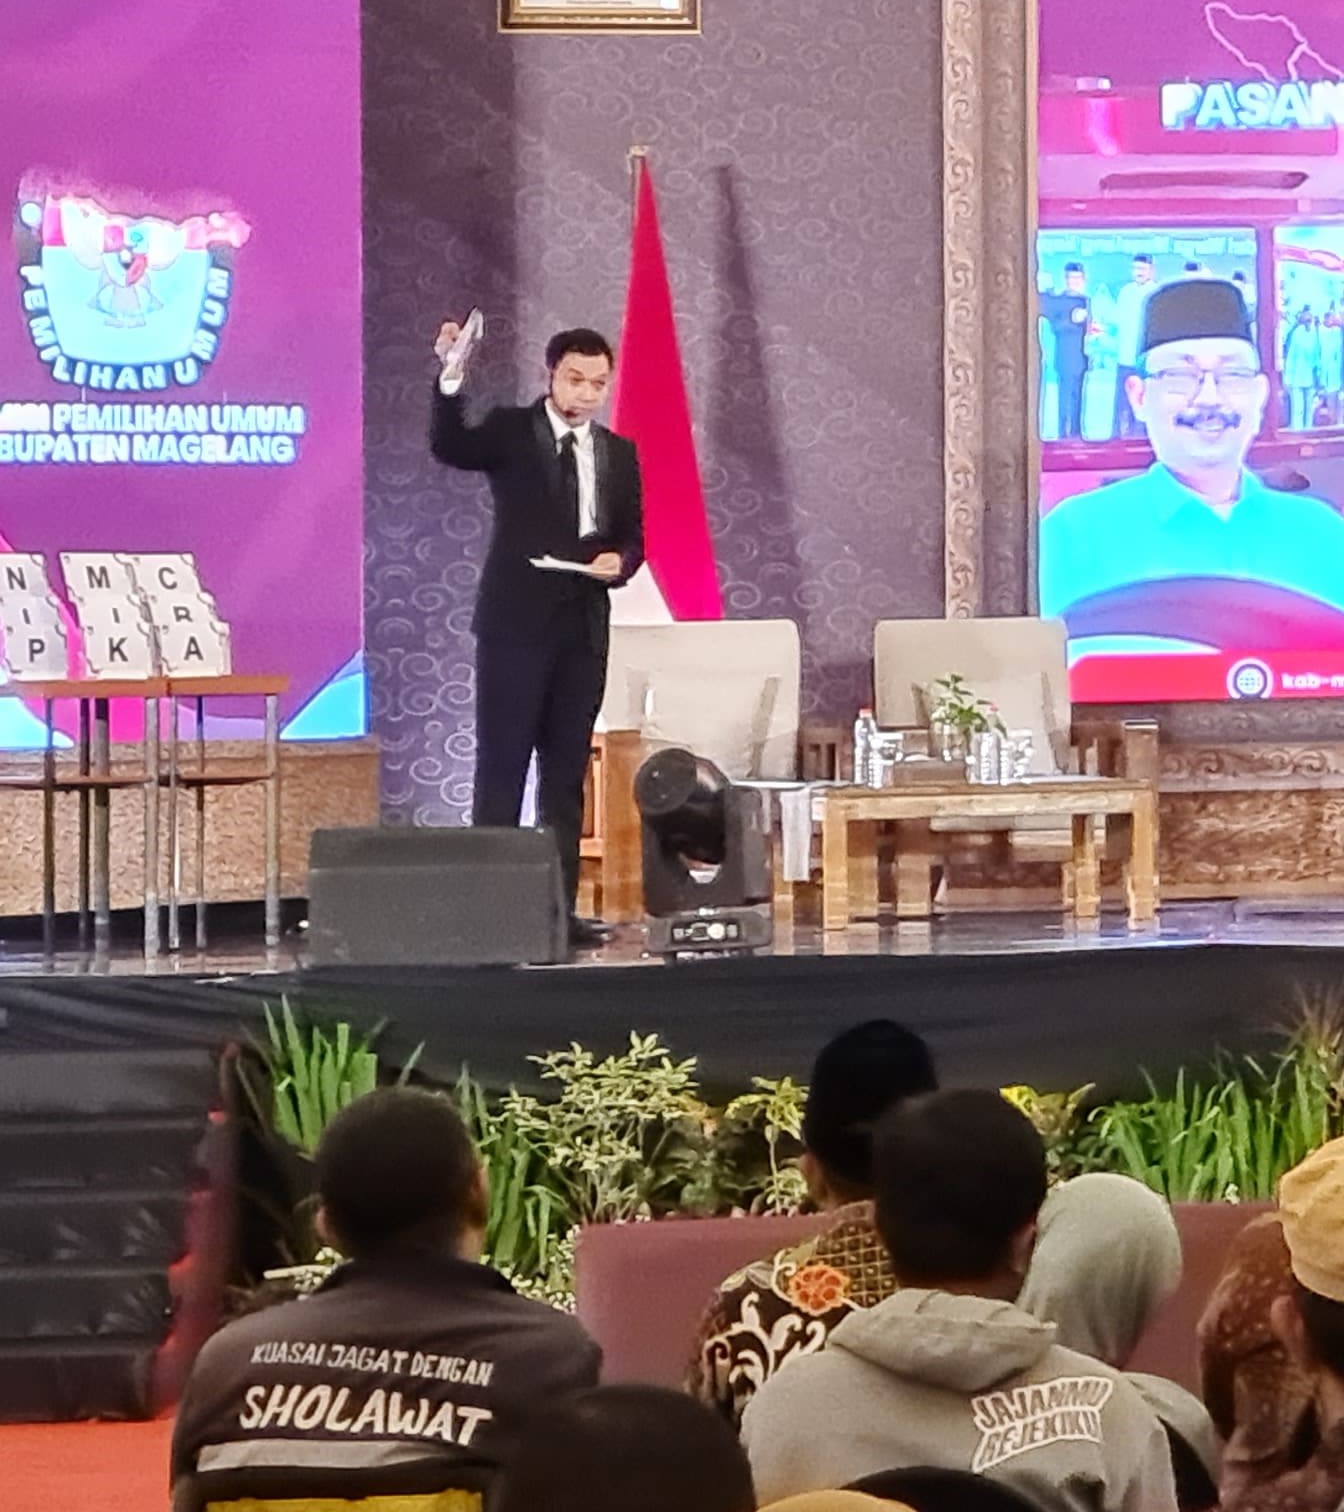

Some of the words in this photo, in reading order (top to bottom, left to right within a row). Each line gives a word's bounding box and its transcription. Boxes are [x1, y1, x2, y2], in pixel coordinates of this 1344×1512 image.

[20, 265, 167, 391] PEMILIHAN
[173, 267, 230, 385] UMUM
[53, 403, 210, 433] PEMILIHAN
[210, 404, 305, 434] UMUM
[0, 433, 130, 463] BUPATEN
[131, 434, 297, 464] MAGELANG
[6, 566, 27, 591] N
[85, 565, 111, 590] M
[158, 566, 179, 590] C
[28, 638, 46, 663] P
[108, 637, 129, 662] K
[183, 635, 205, 661] A
[250, 1340, 325, 1365] KUASAI
[327, 1344, 409, 1374] JAGAT
[410, 1350, 495, 1387] DENGAN
[239, 1383, 493, 1447] SHOLAWAT
[971, 1377, 1113, 1432] JAJANMU
